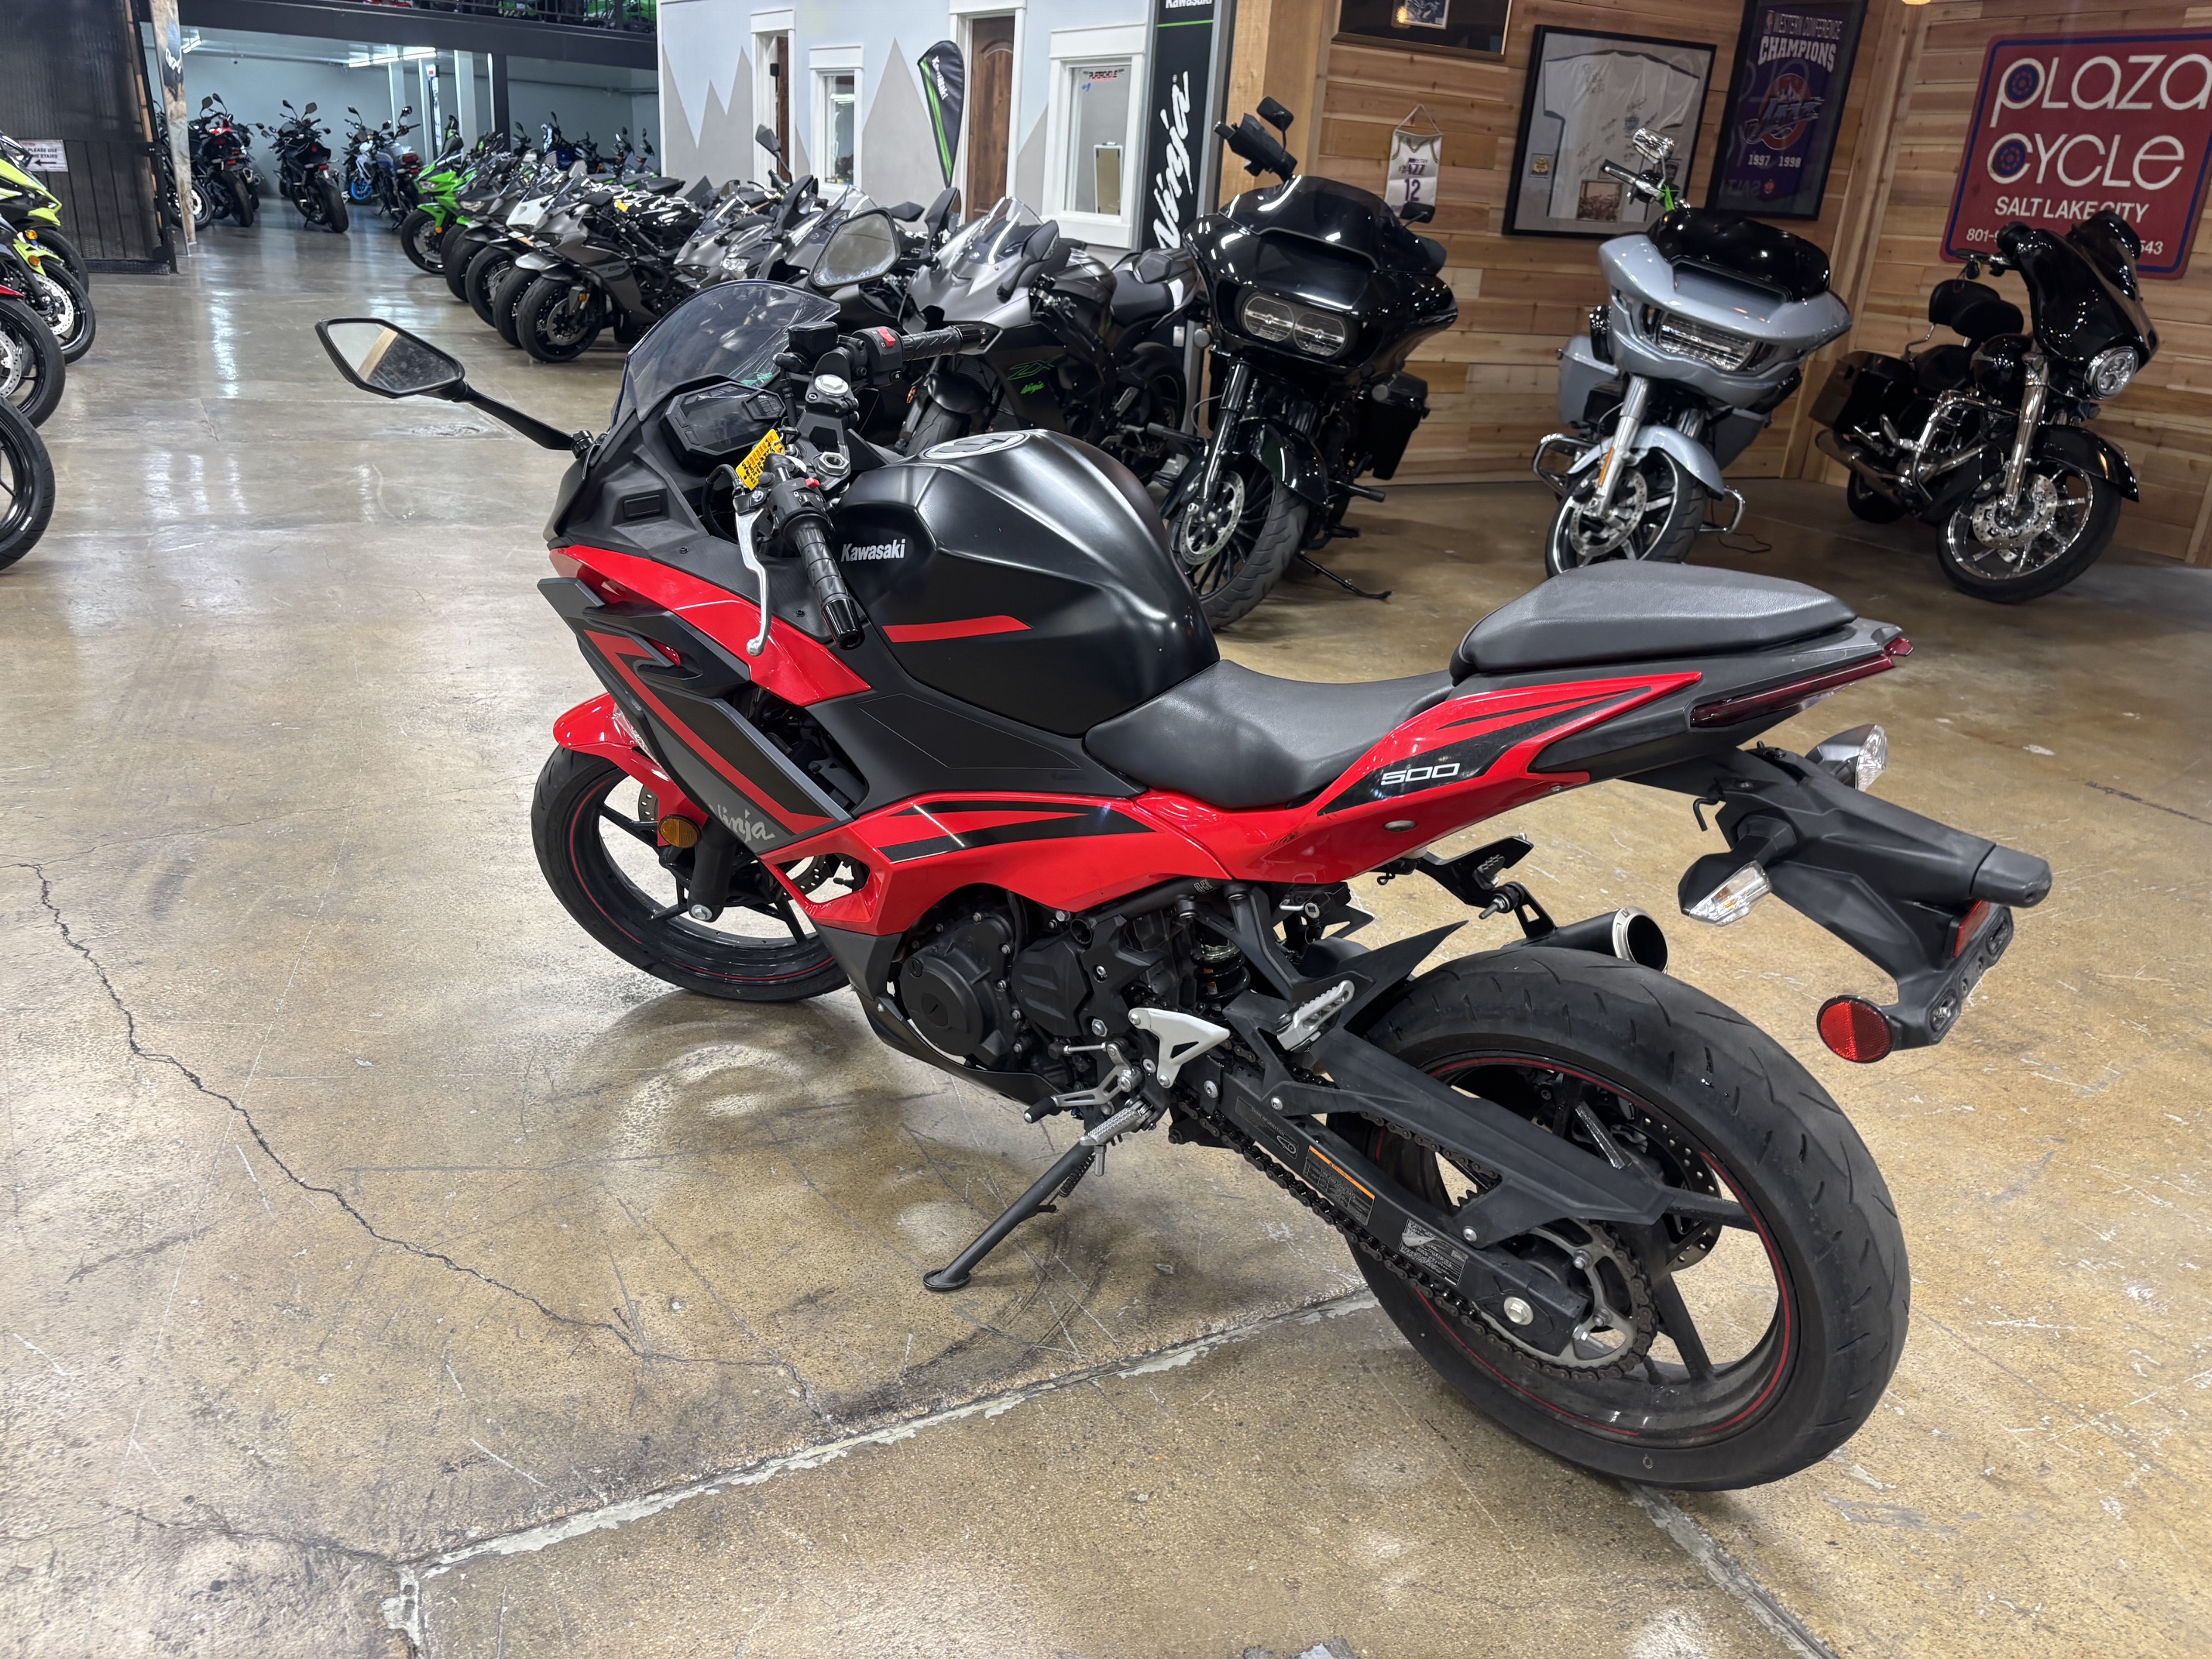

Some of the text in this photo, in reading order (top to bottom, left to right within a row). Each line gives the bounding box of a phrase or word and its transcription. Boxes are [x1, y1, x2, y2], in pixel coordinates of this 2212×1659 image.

[1757, 35, 1837, 74] CHAMPIONS
[1747, 153, 1771, 167] 1997
[1404, 179, 1421, 201] 12
[1994, 196, 2043, 217] SALT
[2043, 198, 2098, 221] LAKE
[840, 538, 906, 562] Kawasaki
[1380, 762, 1461, 786] 500
